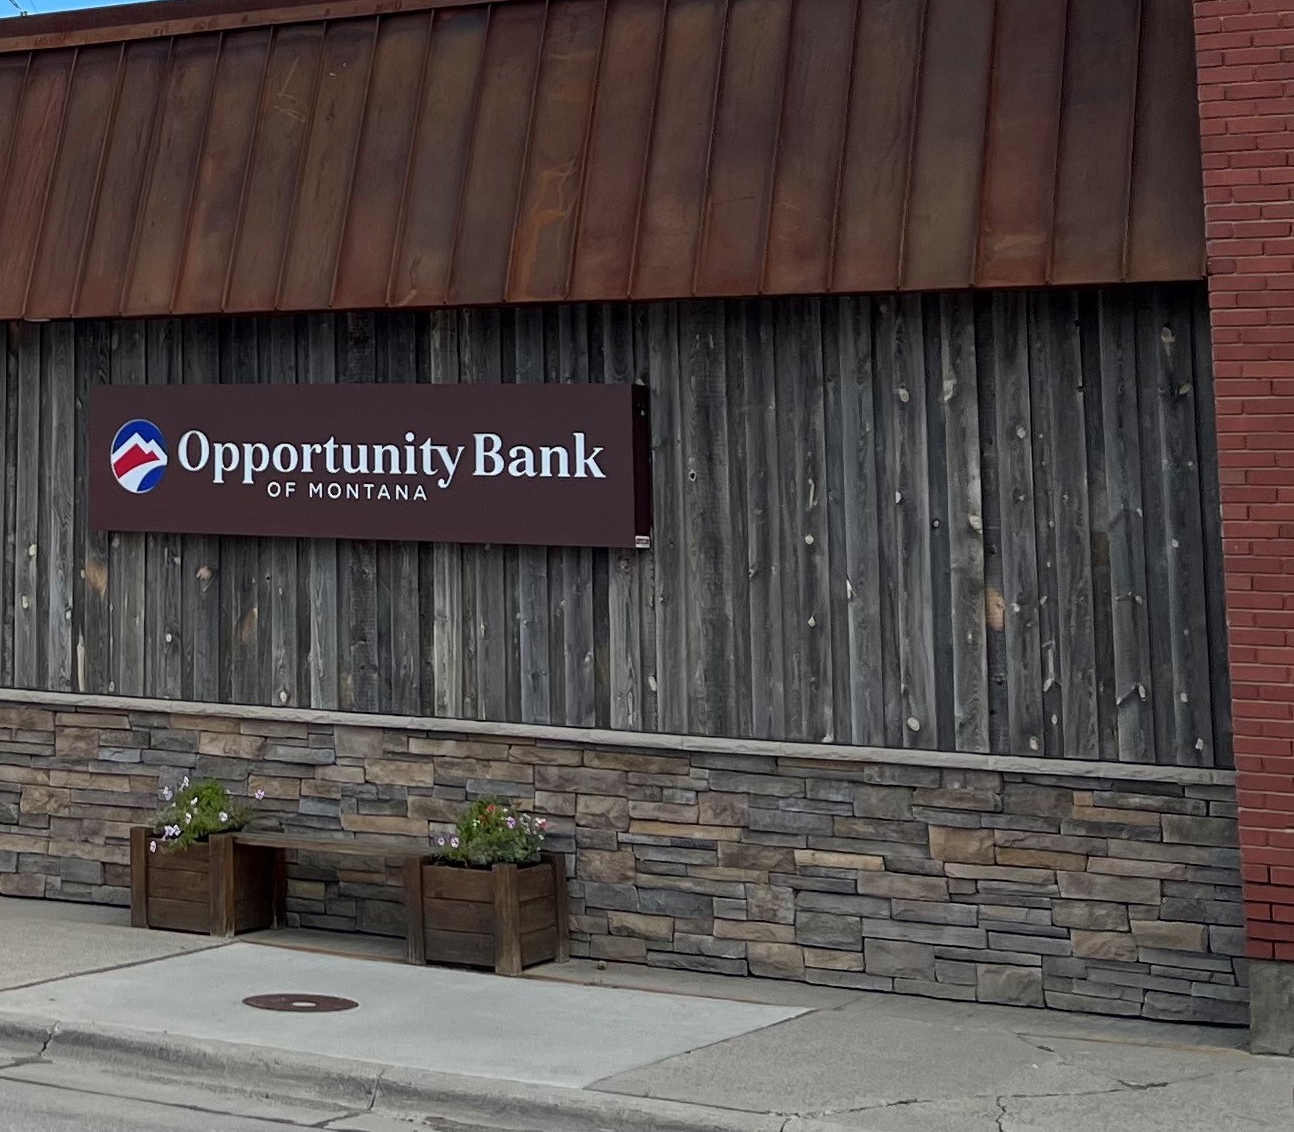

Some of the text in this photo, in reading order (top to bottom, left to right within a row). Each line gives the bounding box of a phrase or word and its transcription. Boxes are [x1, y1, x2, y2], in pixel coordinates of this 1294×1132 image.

[177, 430, 607, 489] Opportunity Bank
[267, 481, 427, 501] OF MONTANA
